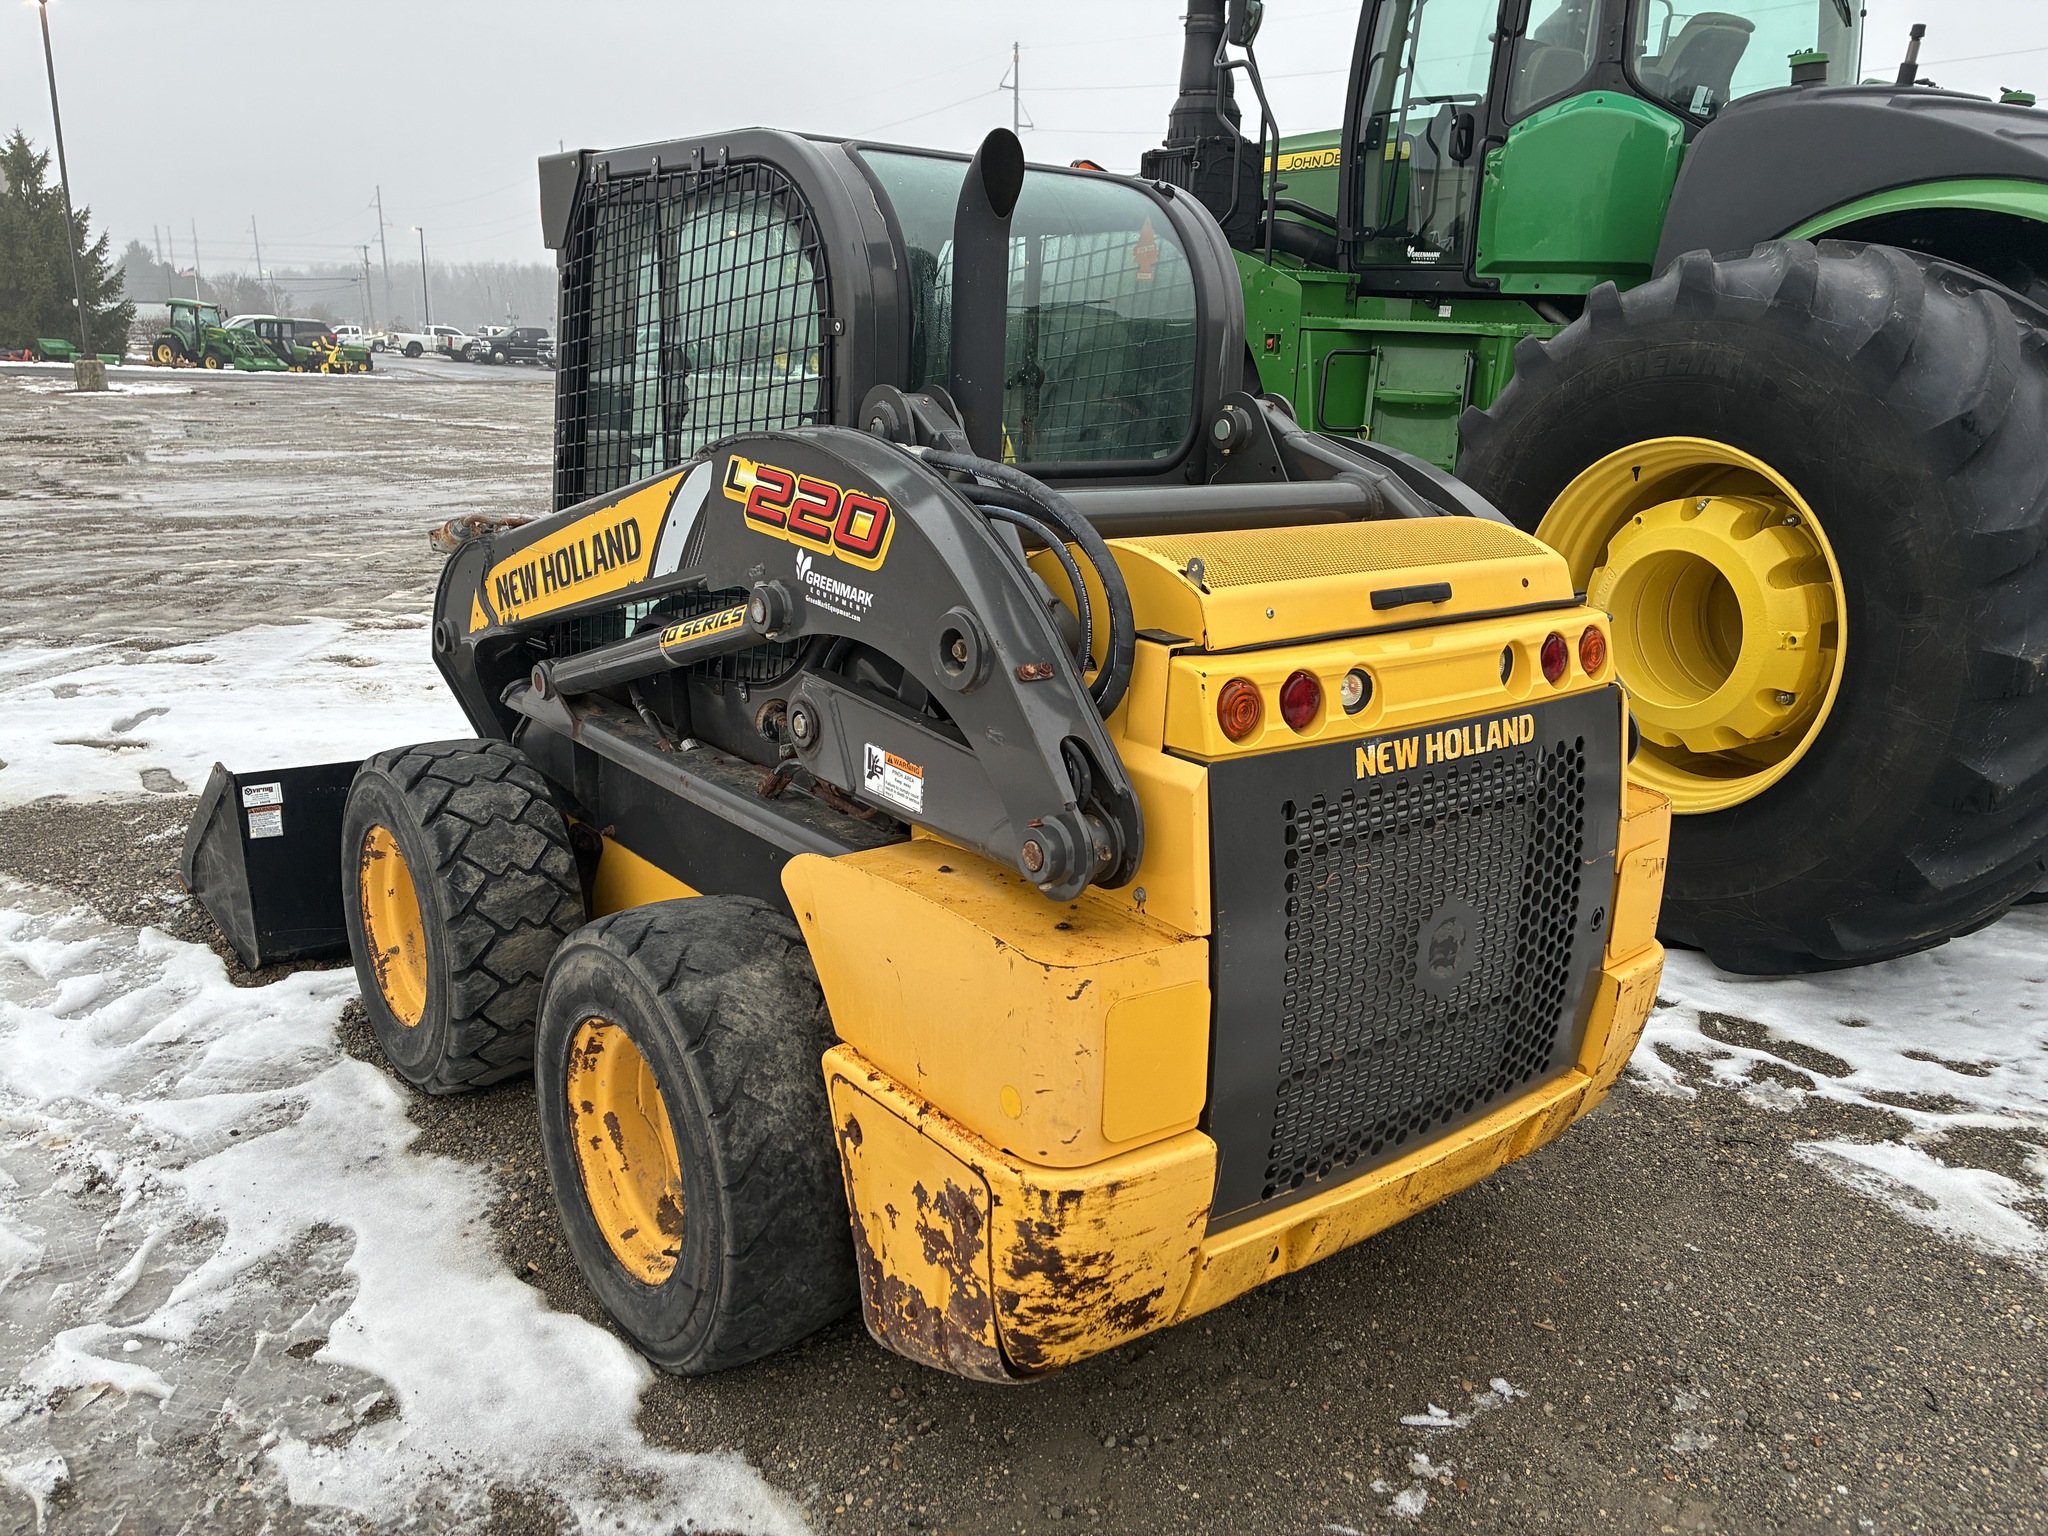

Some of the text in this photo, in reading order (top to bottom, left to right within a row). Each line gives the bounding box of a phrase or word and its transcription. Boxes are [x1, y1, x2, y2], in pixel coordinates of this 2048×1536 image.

[1286, 156, 1321, 170] JOHN
[724, 457, 892, 562] L220
[496, 517, 642, 611] NEW HOLLAND
[806, 571, 874, 607] GREENMARK
[810, 587, 867, 613] EQUIPMENT
[681, 606, 746, 638] SERIES
[1356, 714, 1535, 780] NEW HOLLAND
